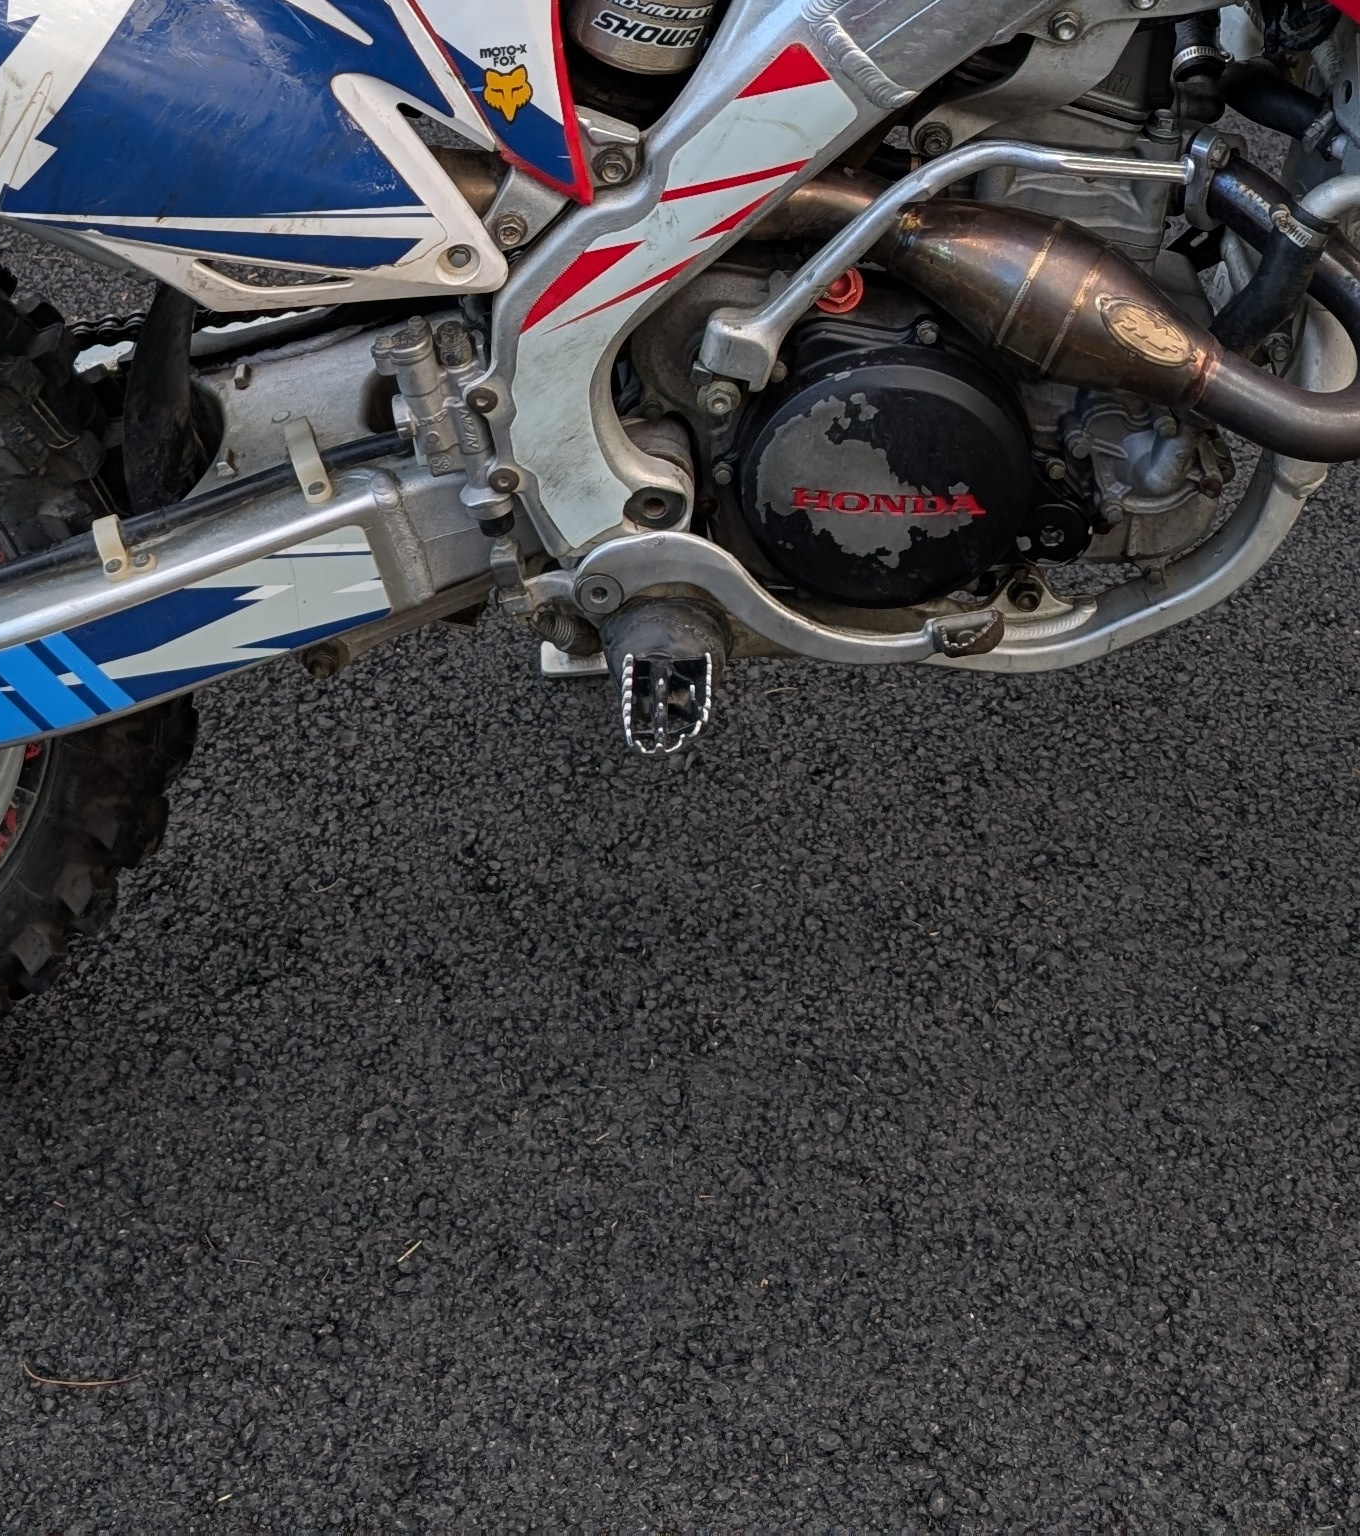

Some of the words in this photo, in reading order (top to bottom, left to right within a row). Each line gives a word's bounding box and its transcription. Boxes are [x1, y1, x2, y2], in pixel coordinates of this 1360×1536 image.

[591, 10, 705, 49] SHOWA
[480, 43, 527, 59] MOTO-X
[493, 55, 518, 68] FOX
[791, 487, 987, 517] HONDA
